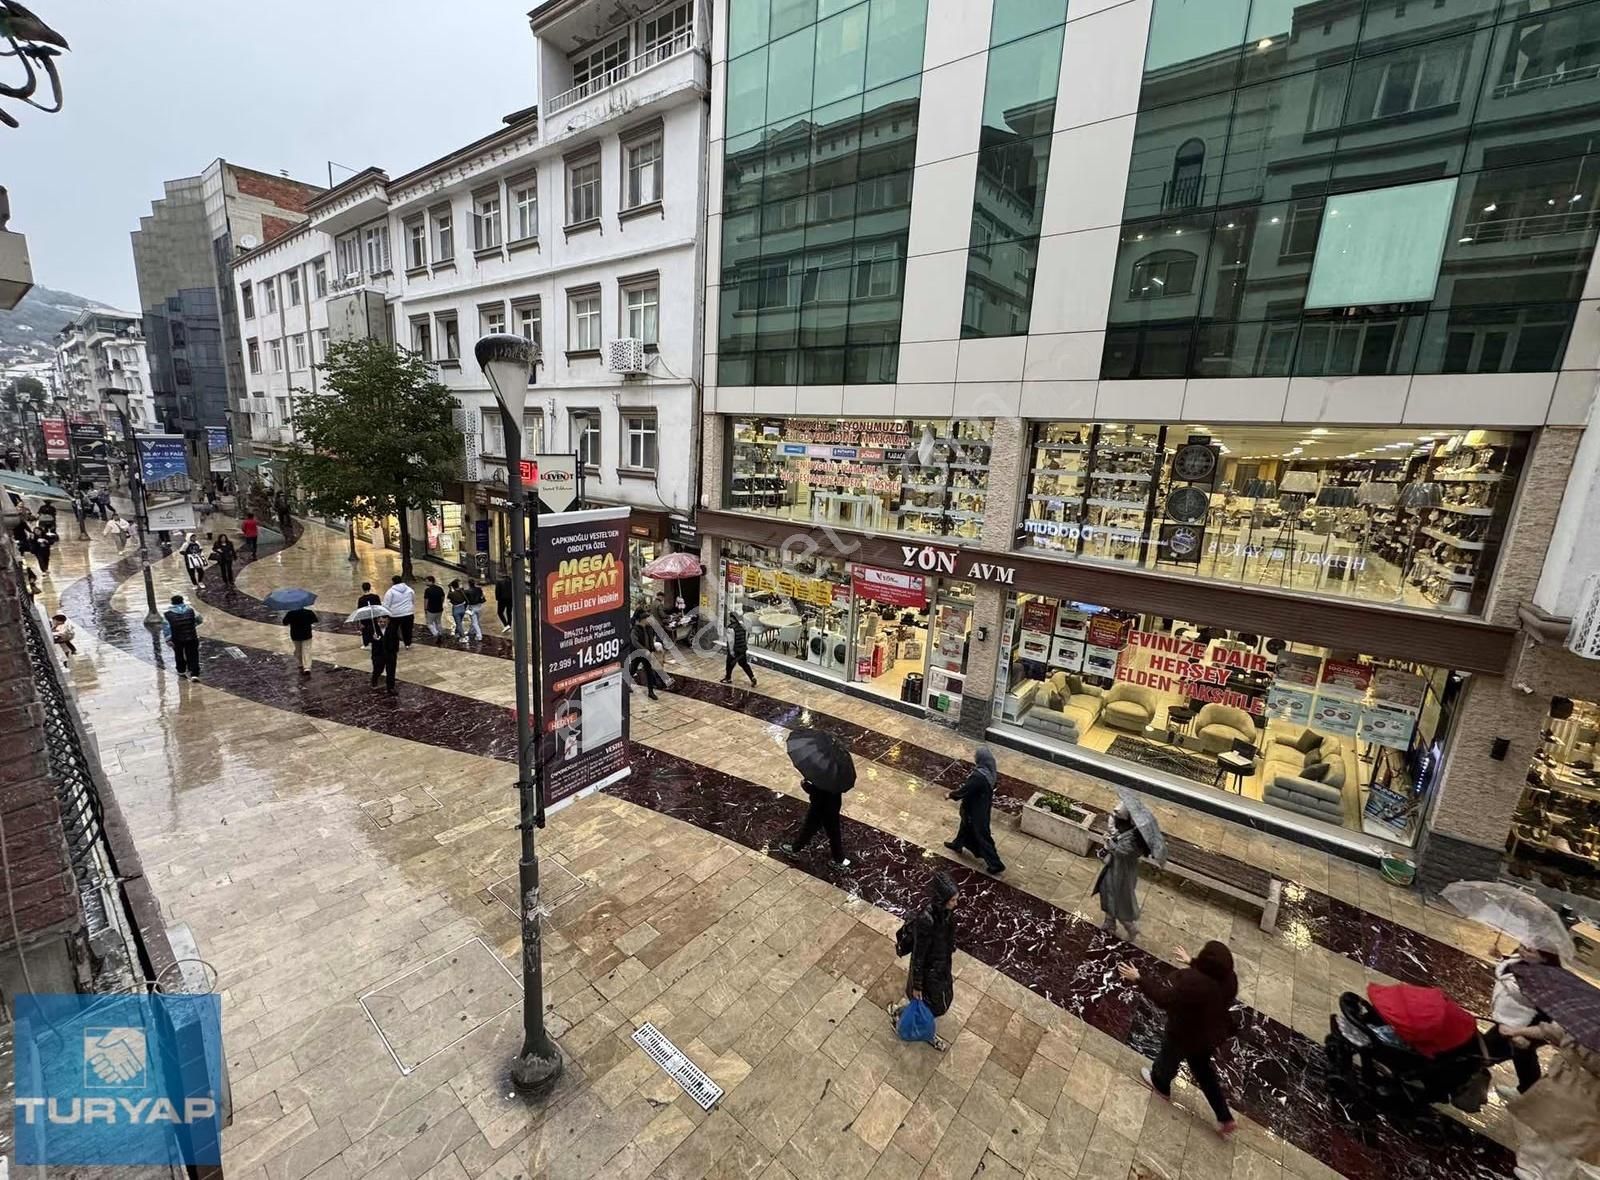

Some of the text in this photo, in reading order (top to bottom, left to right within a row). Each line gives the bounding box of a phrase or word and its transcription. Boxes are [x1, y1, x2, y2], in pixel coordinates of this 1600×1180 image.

[593, 541, 607, 549] ÖZEL
[559, 552, 615, 578] MEGA
[901, 545, 1015, 584] YÖN AVM
[552, 570, 619, 599] FIRSAT
[554, 599, 583, 615] HEDİYELİ
[584, 597, 597, 608] DEV
[594, 621, 611, 633] Program
[549, 658, 572, 673] 22.999
[577, 638, 620, 668] 14.999
[1128, 630, 1207, 660] EVİNİZE
[1211, 645, 1268, 672] DAİR
[1117, 665, 1171, 692] ELDEN
[1177, 678, 1265, 716] TAKSİTLE
[605, 741, 623, 754] VESTEL
